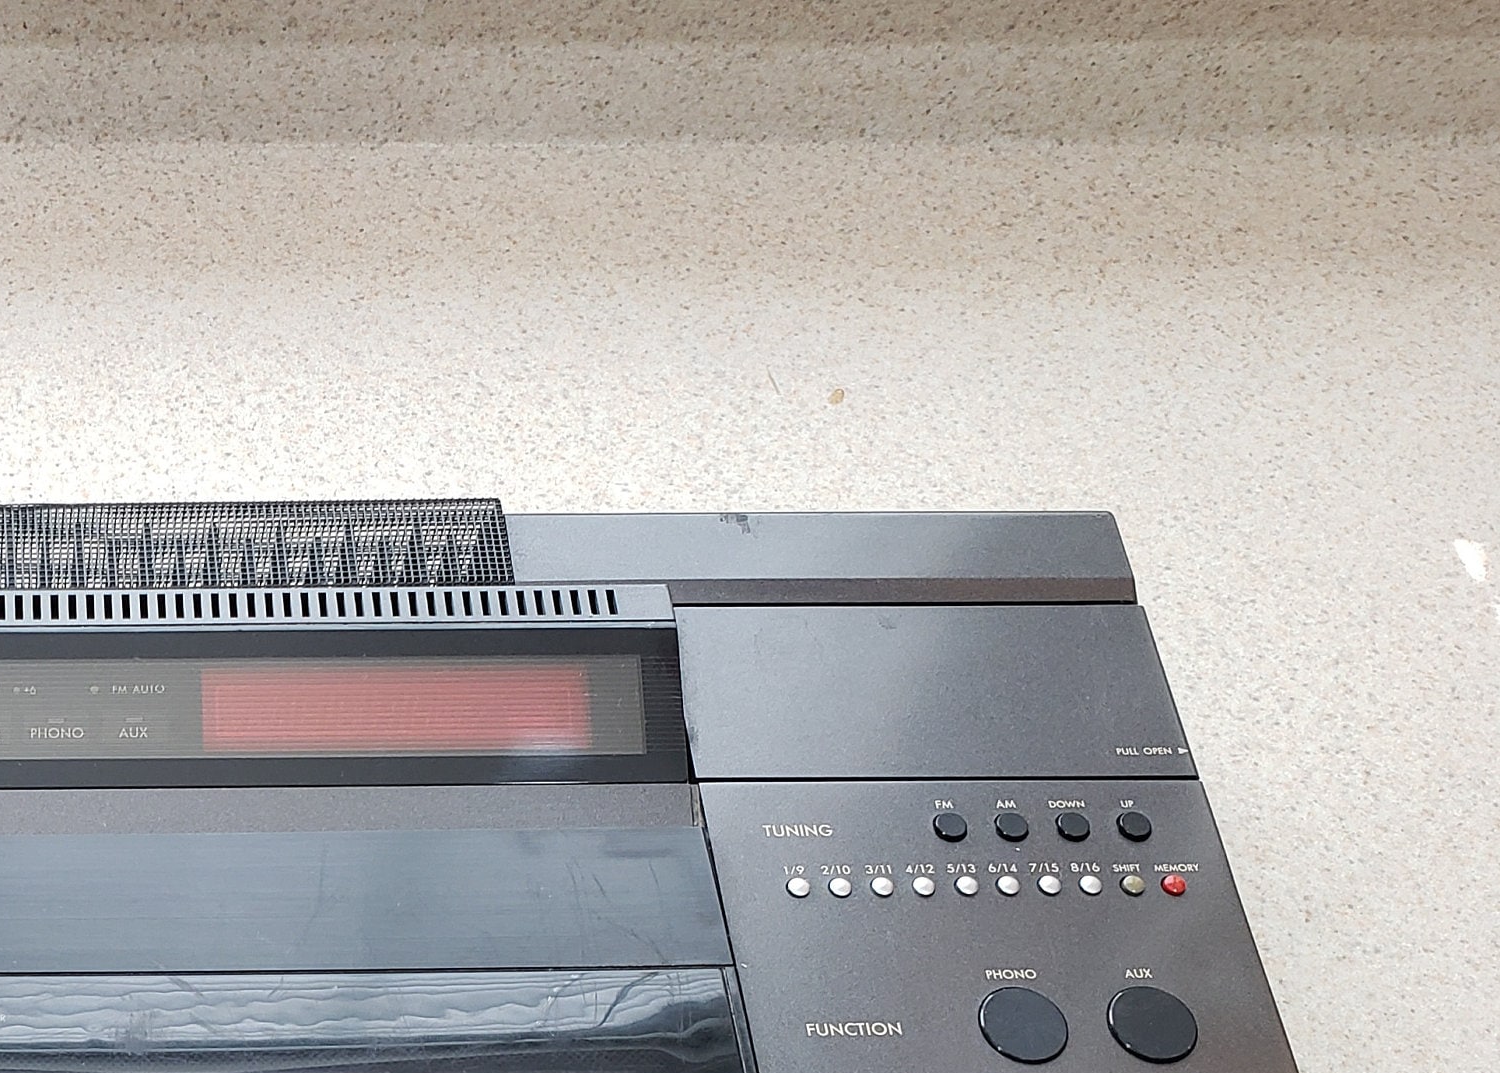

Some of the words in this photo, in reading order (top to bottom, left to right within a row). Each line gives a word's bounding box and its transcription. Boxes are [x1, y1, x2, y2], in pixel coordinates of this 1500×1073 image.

[30, 727, 84, 739] PHONO
[118, 727, 148, 739] AUX
[1115, 747, 1140, 756] PULL
[1143, 746, 1173, 756] OPEN
[934, 800, 954, 809] FM
[996, 800, 1016, 809] AM
[1048, 799, 1086, 809] DOWN
[1120, 800, 1134, 809] UP
[762, 823, 833, 838] TUNING
[783, 864, 805, 876] 1/9
[820, 864, 851, 876] 2/10
[865, 864, 892, 875] 3/11
[905, 864, 935, 875] 4/12
[946, 864, 976, 874] 5/13
[988, 863, 1018, 874] 6/14
[1029, 863, 1060, 874] 7/15
[1070, 862, 1100, 873] 8/16
[1112, 863, 1141, 873] SHIFT
[1154, 863, 1200, 873] MEMORY
[985, 968, 1037, 981] PHONO
[1125, 968, 1153, 979] AUX
[805, 1022, 903, 1037] FUNCTION
